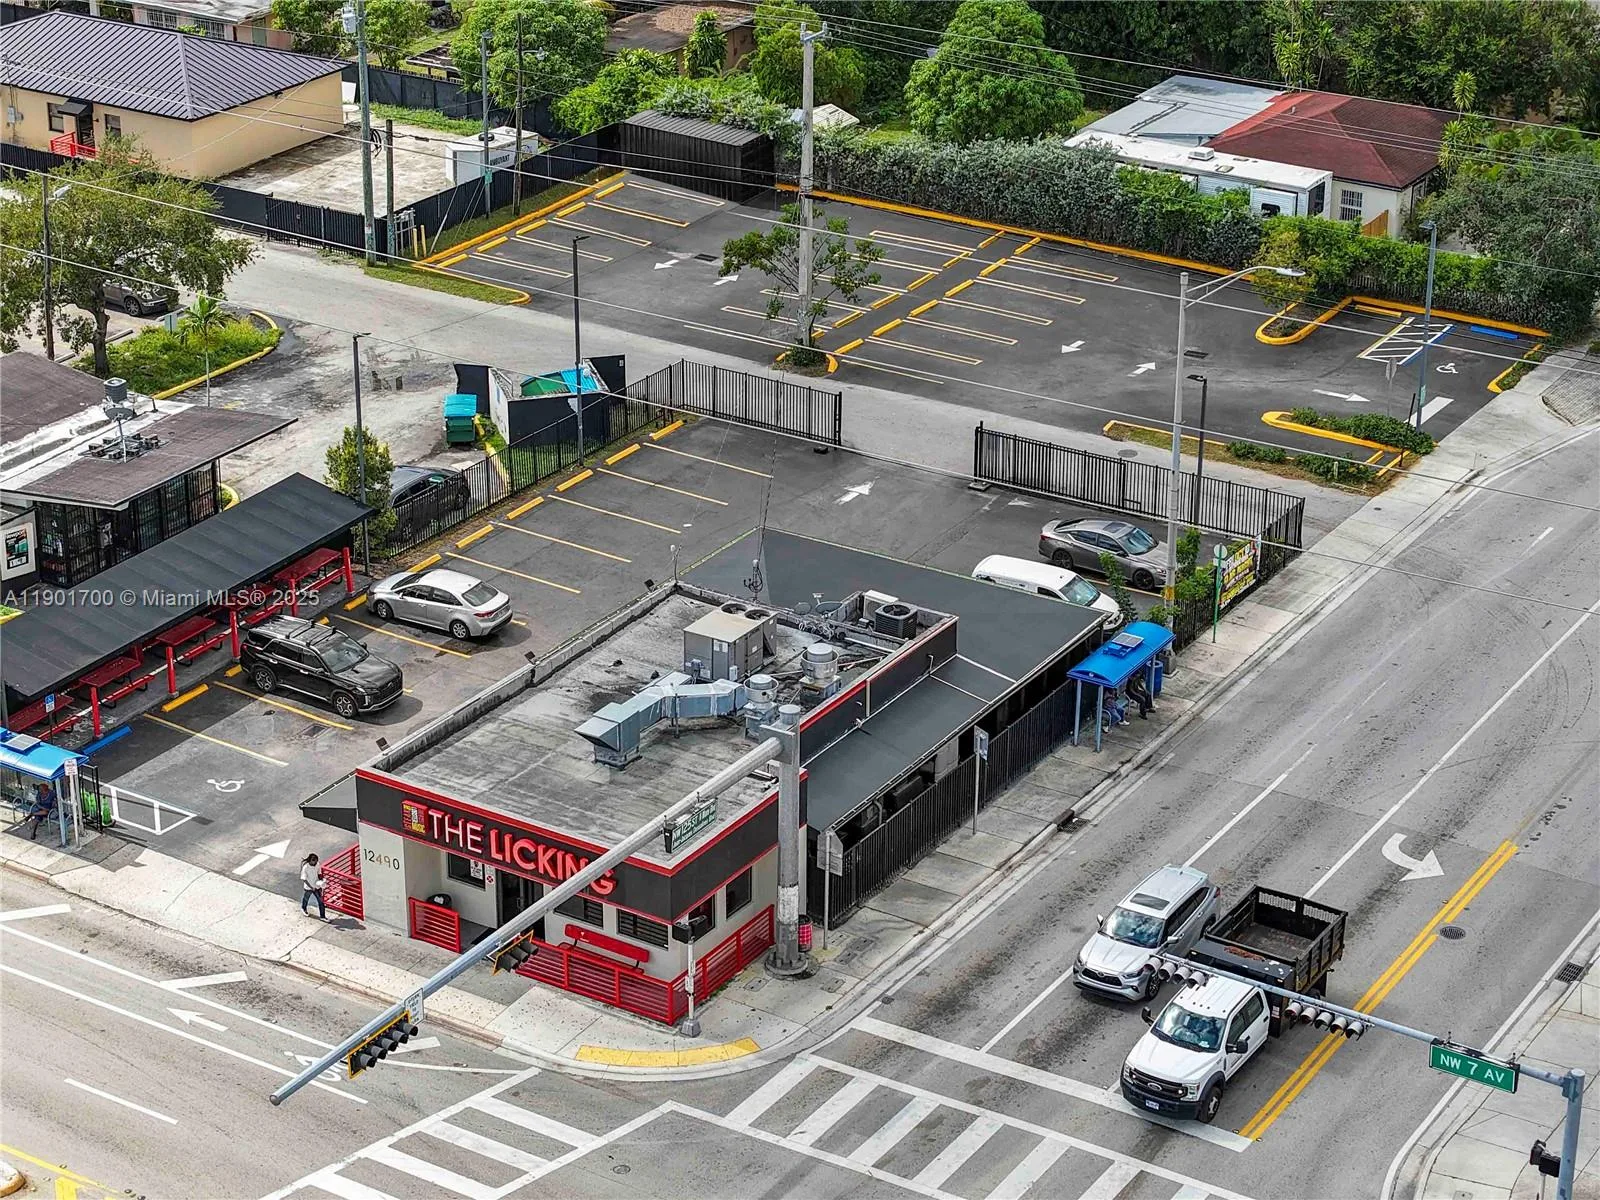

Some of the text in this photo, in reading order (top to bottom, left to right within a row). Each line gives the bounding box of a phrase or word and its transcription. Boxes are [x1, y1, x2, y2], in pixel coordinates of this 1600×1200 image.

[428, 808, 484, 854] THE
[363, 848, 400, 871] 12490
[1440, 1053, 1505, 1083] NW 7 AV
